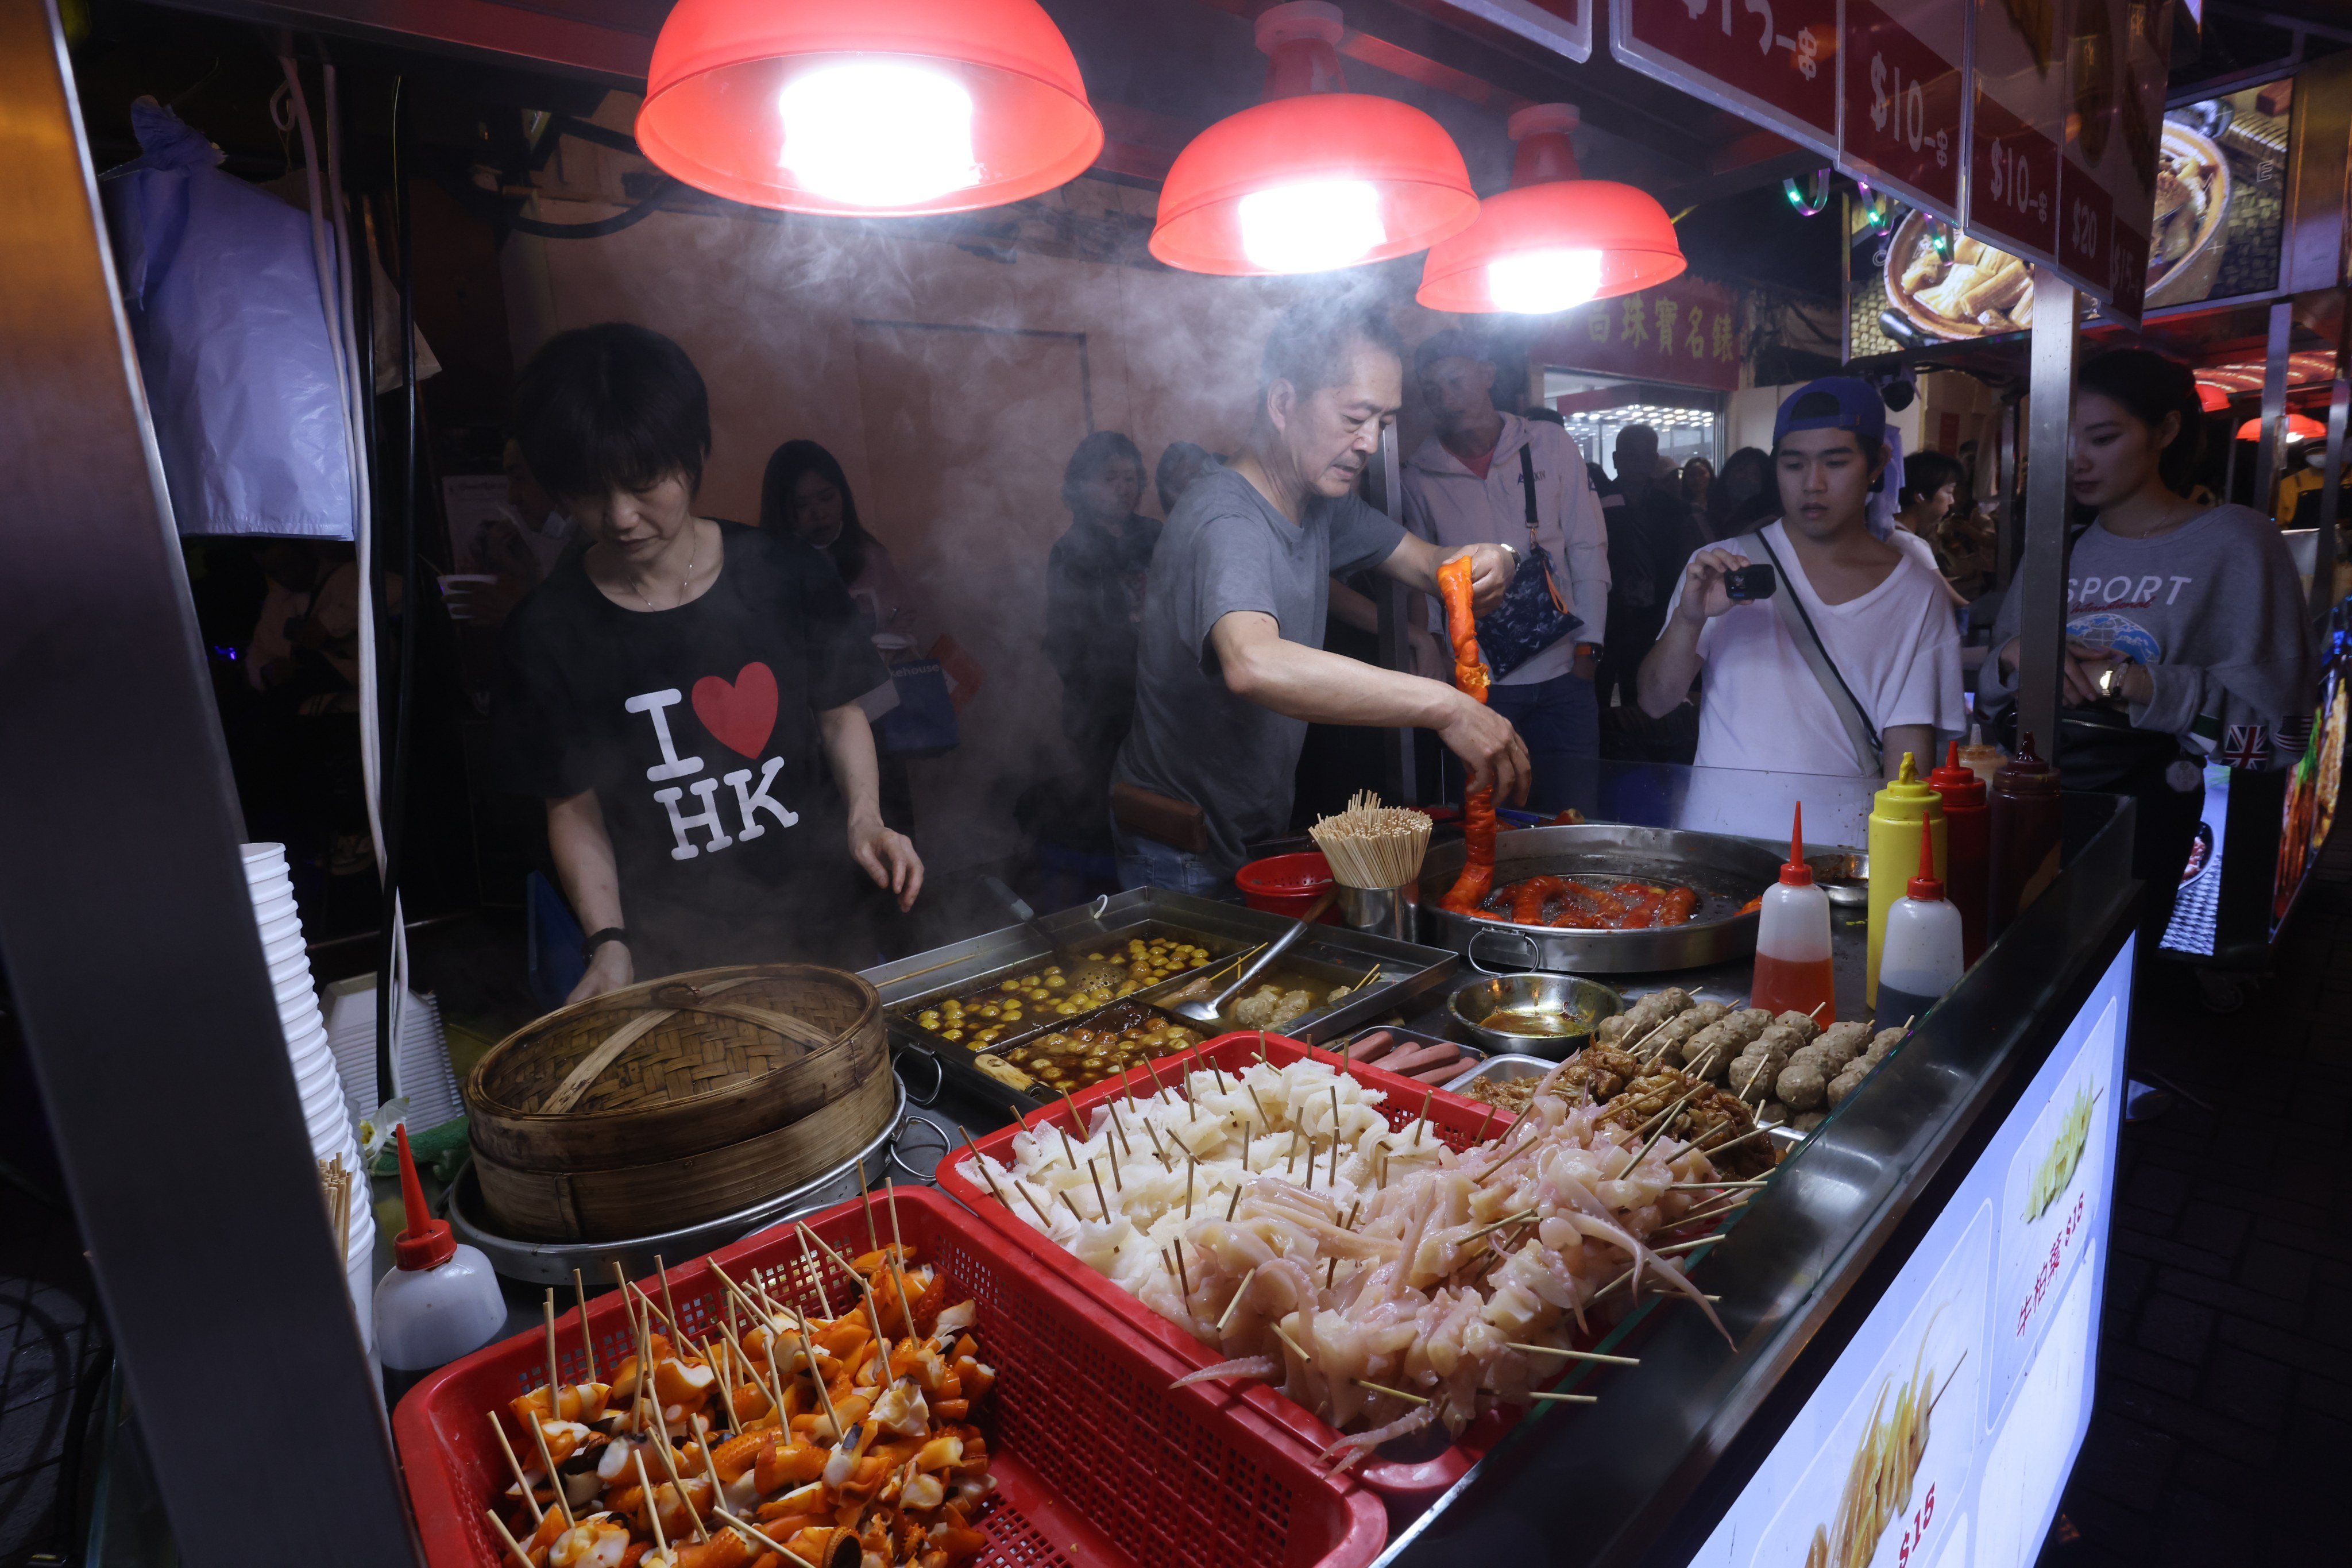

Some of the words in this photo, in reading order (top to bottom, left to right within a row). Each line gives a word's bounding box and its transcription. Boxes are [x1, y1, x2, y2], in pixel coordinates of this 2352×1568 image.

[2072, 196, 2098, 260] $20
[625, 688, 704, 782] I
[654, 756, 799, 860] HK
[2065, 1191, 2084, 1248] $15
[1899, 1481, 1936, 1568] $15
